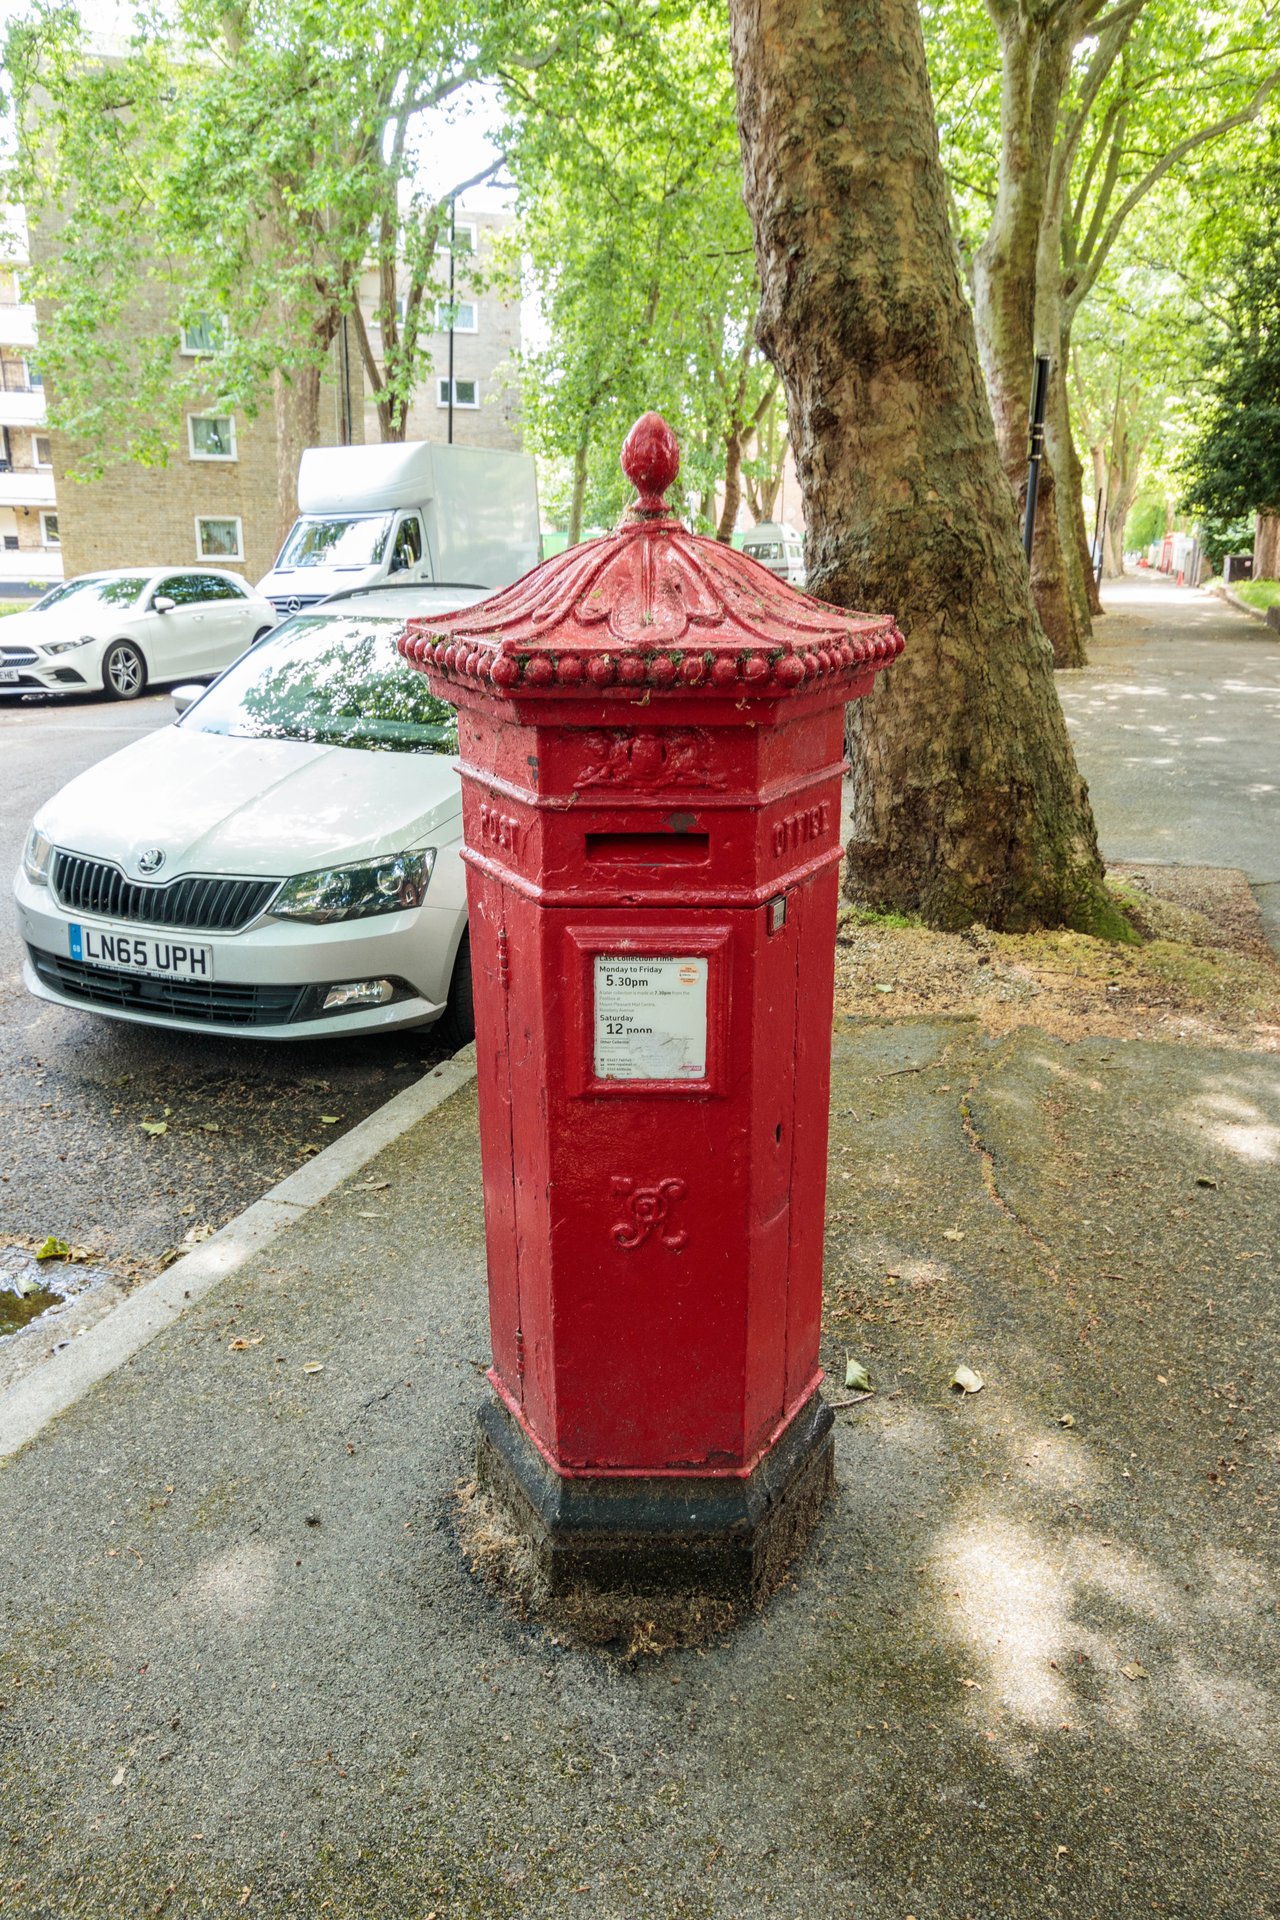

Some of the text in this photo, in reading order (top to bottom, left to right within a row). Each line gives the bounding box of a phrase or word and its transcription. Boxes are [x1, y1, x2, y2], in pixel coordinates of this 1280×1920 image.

[479, 804, 519, 854] POST
[86, 932, 206, 975] LN65 UPH
[599, 966, 628, 974] Monday
[639, 966, 663, 974] Friday
[606, 974, 649, 988] 5.30pm
[606, 1023, 624, 1035] 12
